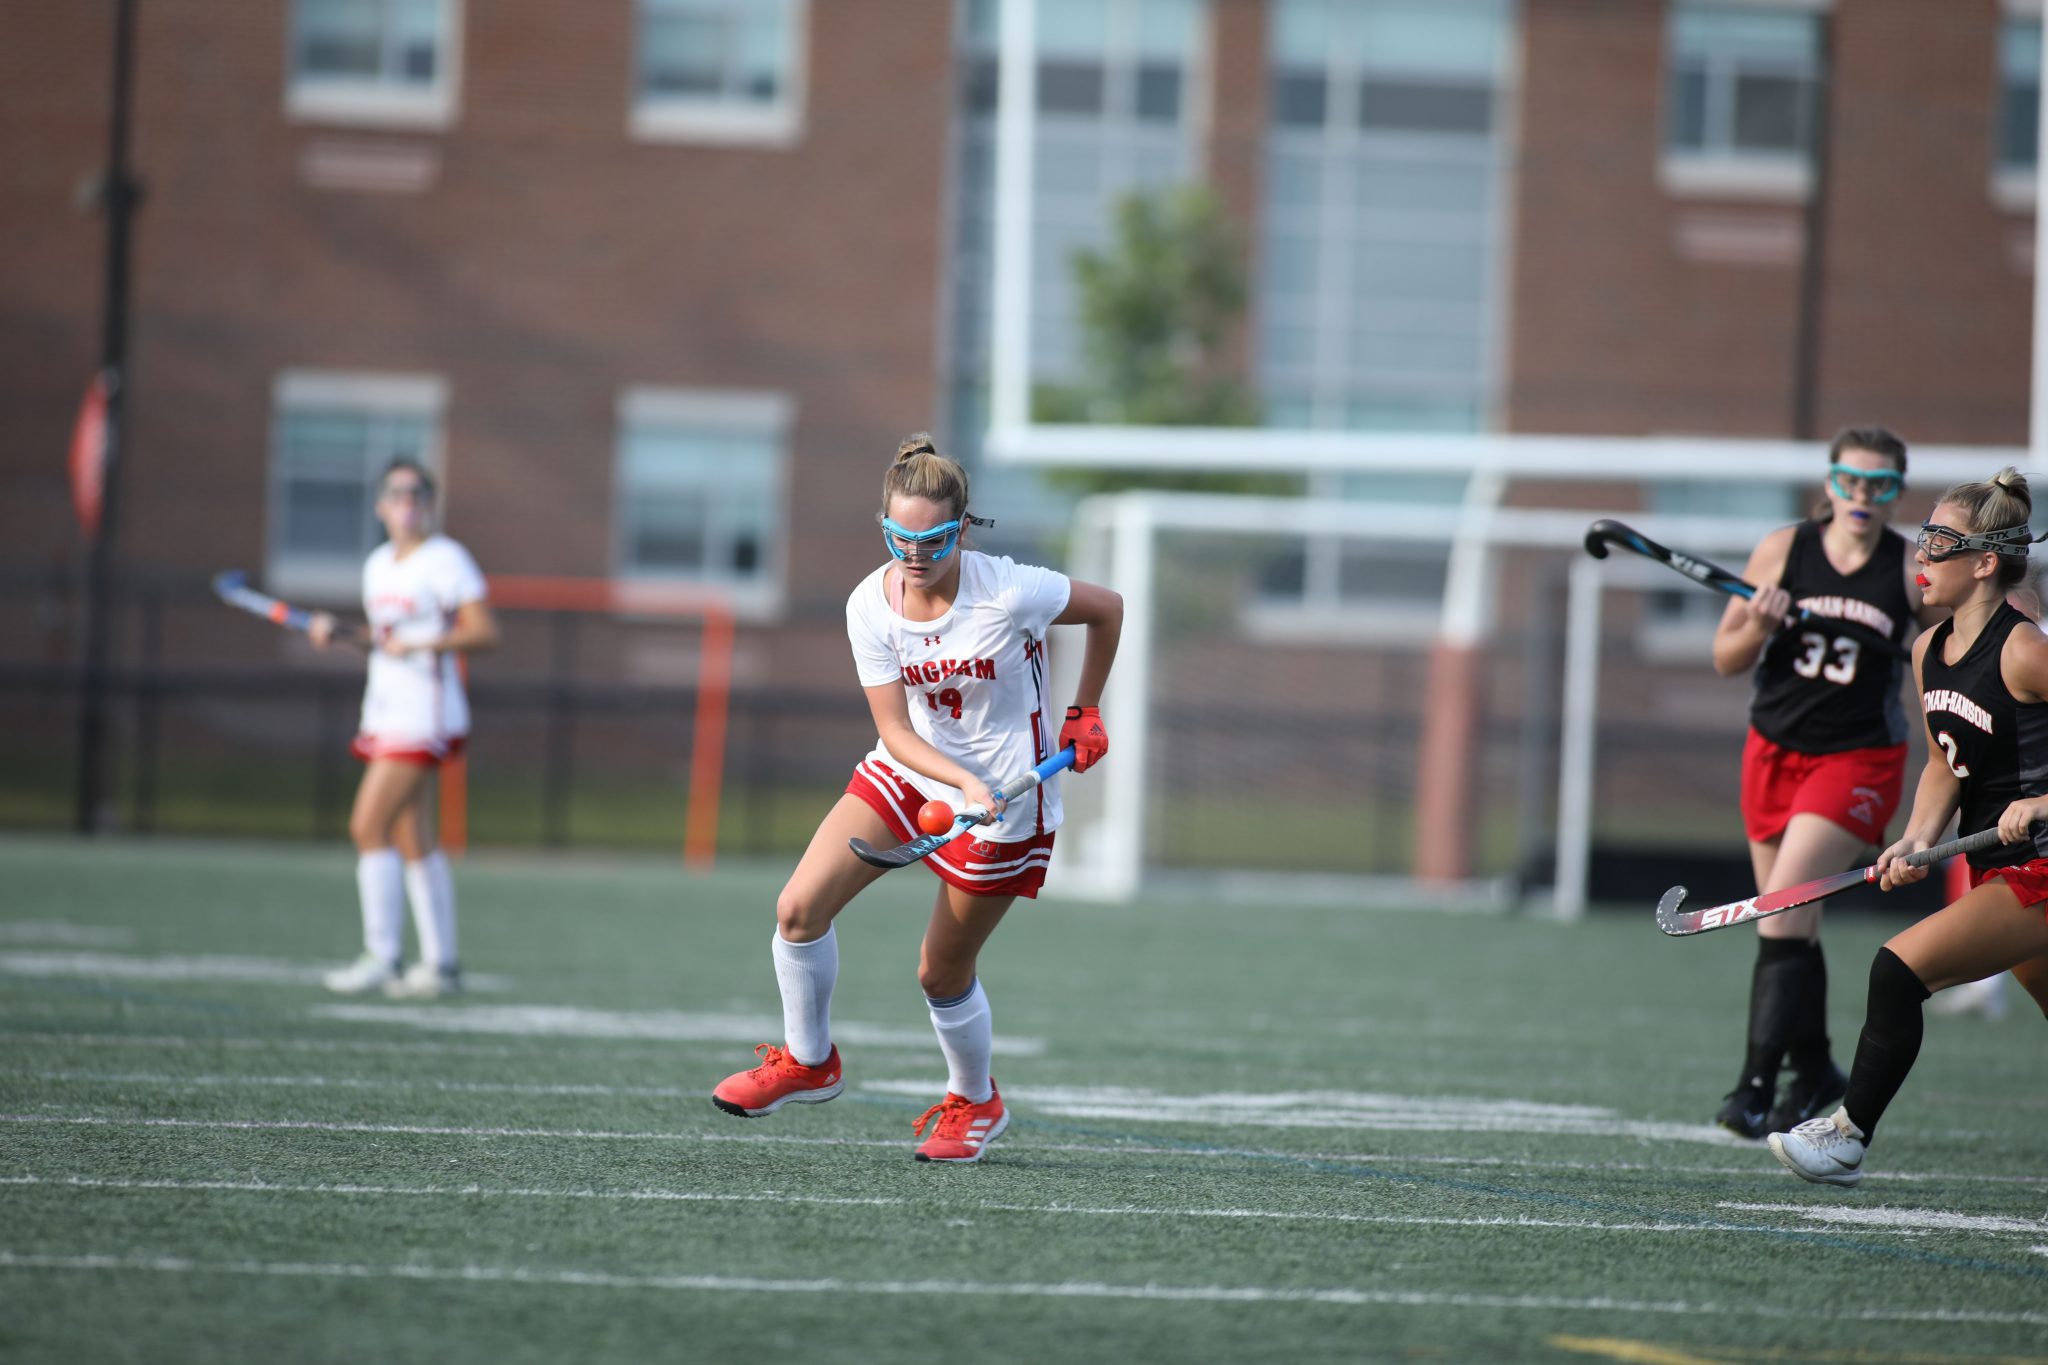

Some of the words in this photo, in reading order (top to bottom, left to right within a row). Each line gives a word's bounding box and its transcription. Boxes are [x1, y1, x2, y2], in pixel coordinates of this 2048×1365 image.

[1981, 541, 2005, 552] STX
[1985, 531, 2009, 541] STX
[1793, 632, 1860, 685] 33
[925, 687, 963, 719] 19
[1937, 731, 1970, 778] 2
[1700, 896, 1761, 930] STX
